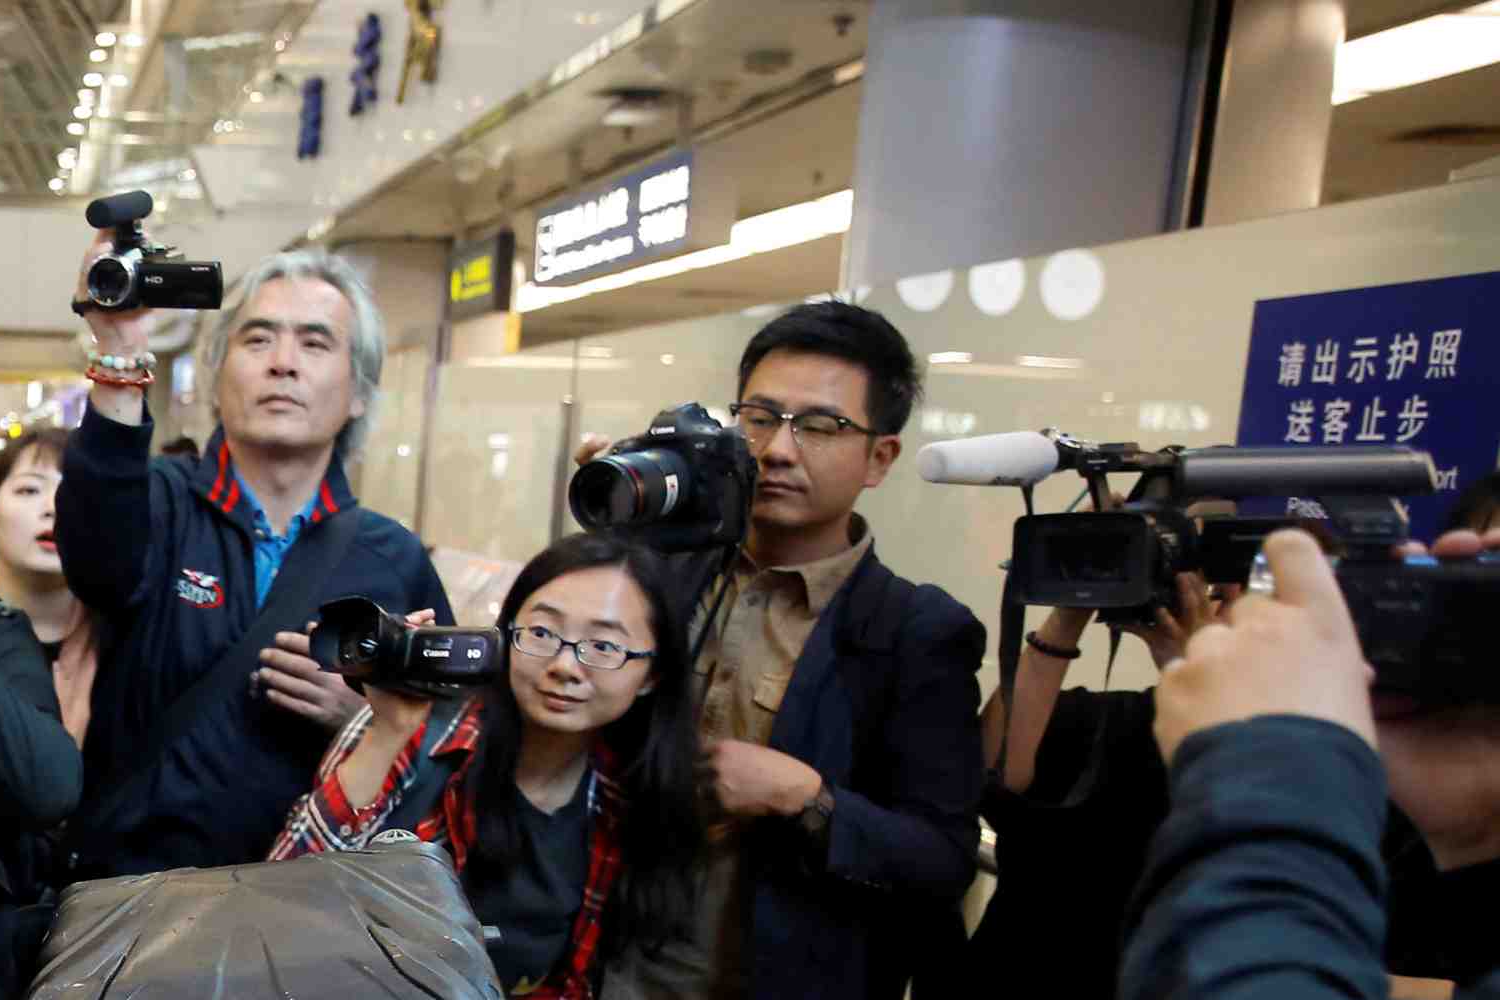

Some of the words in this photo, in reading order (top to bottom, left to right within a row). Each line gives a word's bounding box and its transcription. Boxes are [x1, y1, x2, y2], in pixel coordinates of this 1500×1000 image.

[1278, 328, 1462, 387] 请出示护照
[1284, 394, 1429, 444] 送客止步
